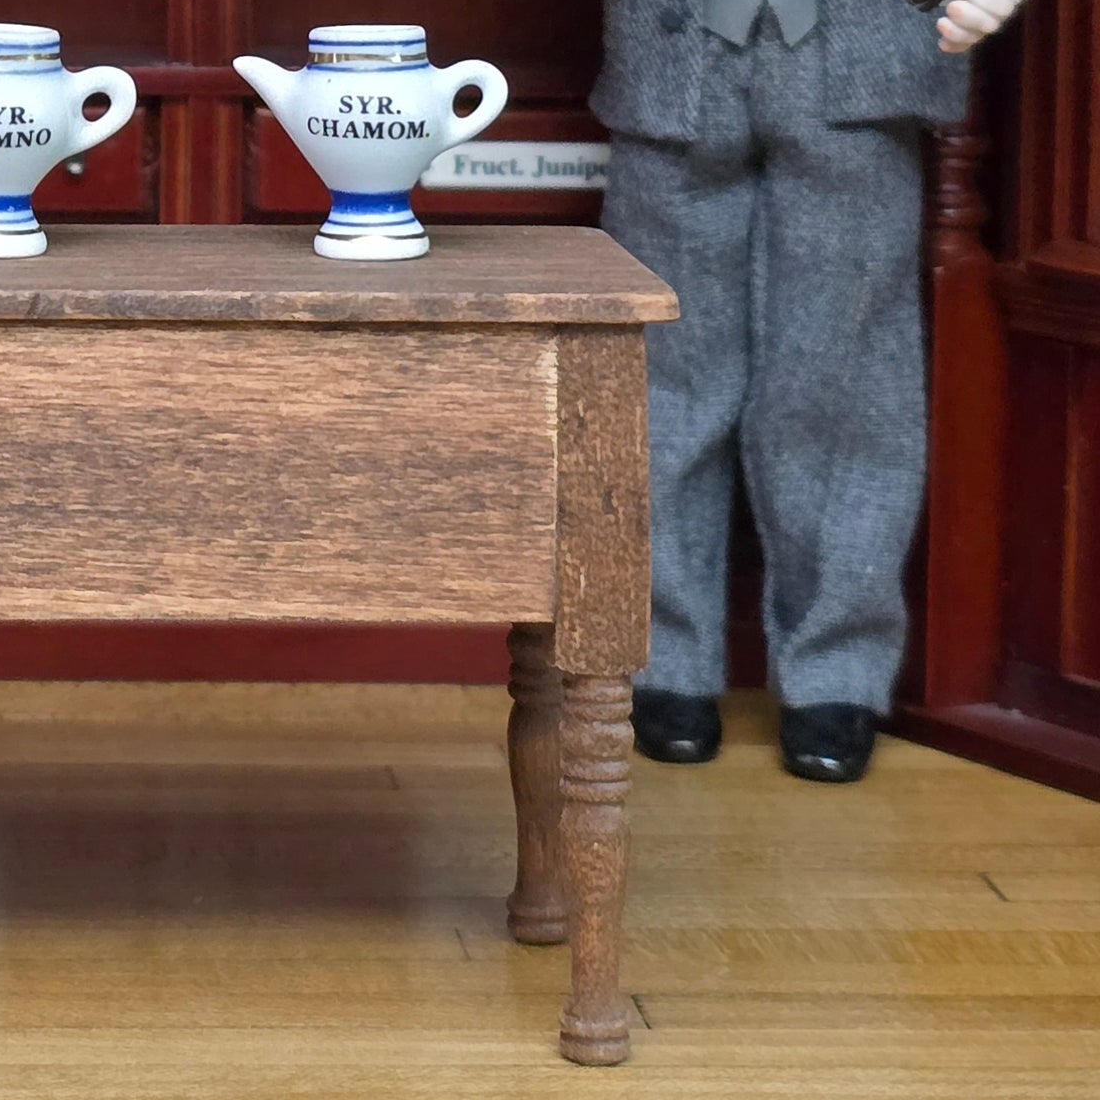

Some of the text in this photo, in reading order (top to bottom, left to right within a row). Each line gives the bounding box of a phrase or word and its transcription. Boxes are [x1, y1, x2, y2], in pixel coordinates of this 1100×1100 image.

[337, 95, 402, 115] SYR.
[306, 116, 432, 140] CHAMOM.
[452, 153, 526, 178] Fruct.
